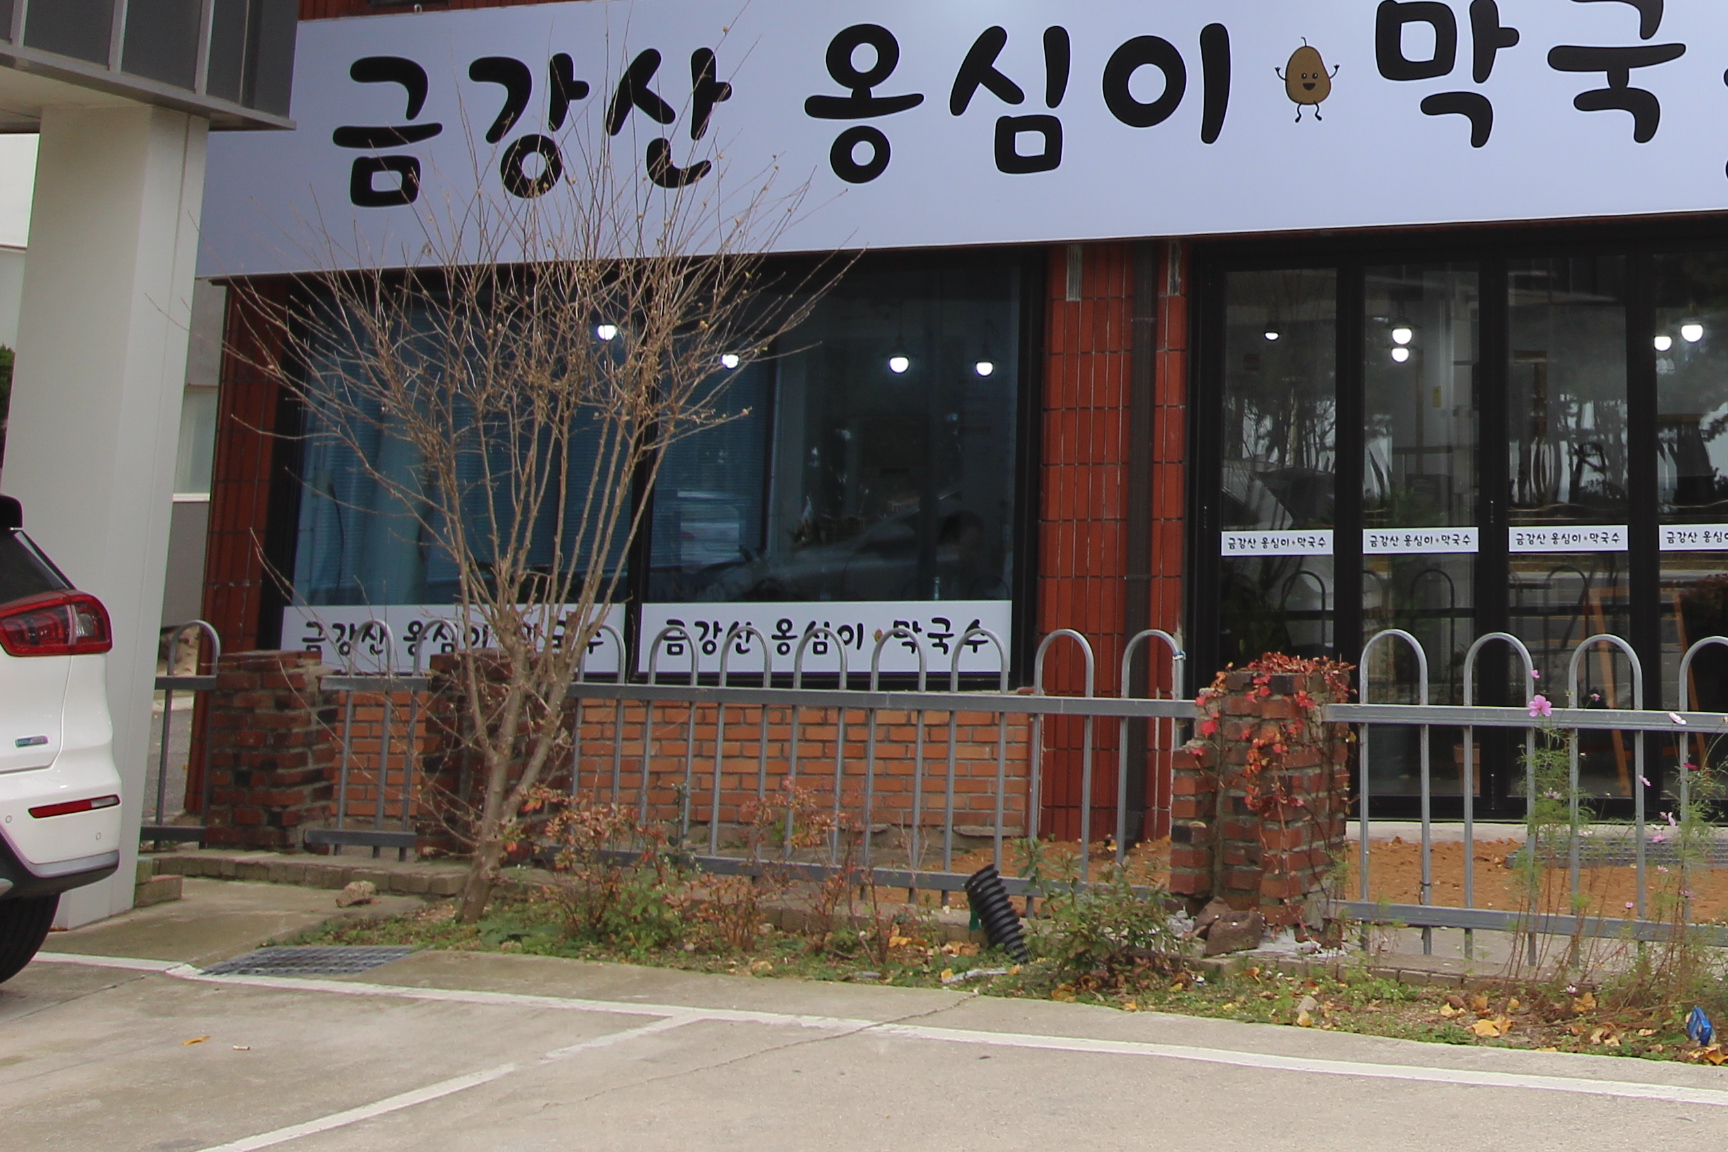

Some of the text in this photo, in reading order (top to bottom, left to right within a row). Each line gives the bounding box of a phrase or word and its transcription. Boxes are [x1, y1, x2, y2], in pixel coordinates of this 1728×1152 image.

[332, 47, 733, 208] 금강산
[804, 22, 1231, 184] 옹심이
[1228, 536, 1327, 550] 금강산 옹심이 막국수
[1369, 533, 1472, 548] 금강산 옹심이 막국수
[1515, 531, 1621, 546] 금강산 옹심이 막국수
[1666, 531, 1698, 544] 금강산
